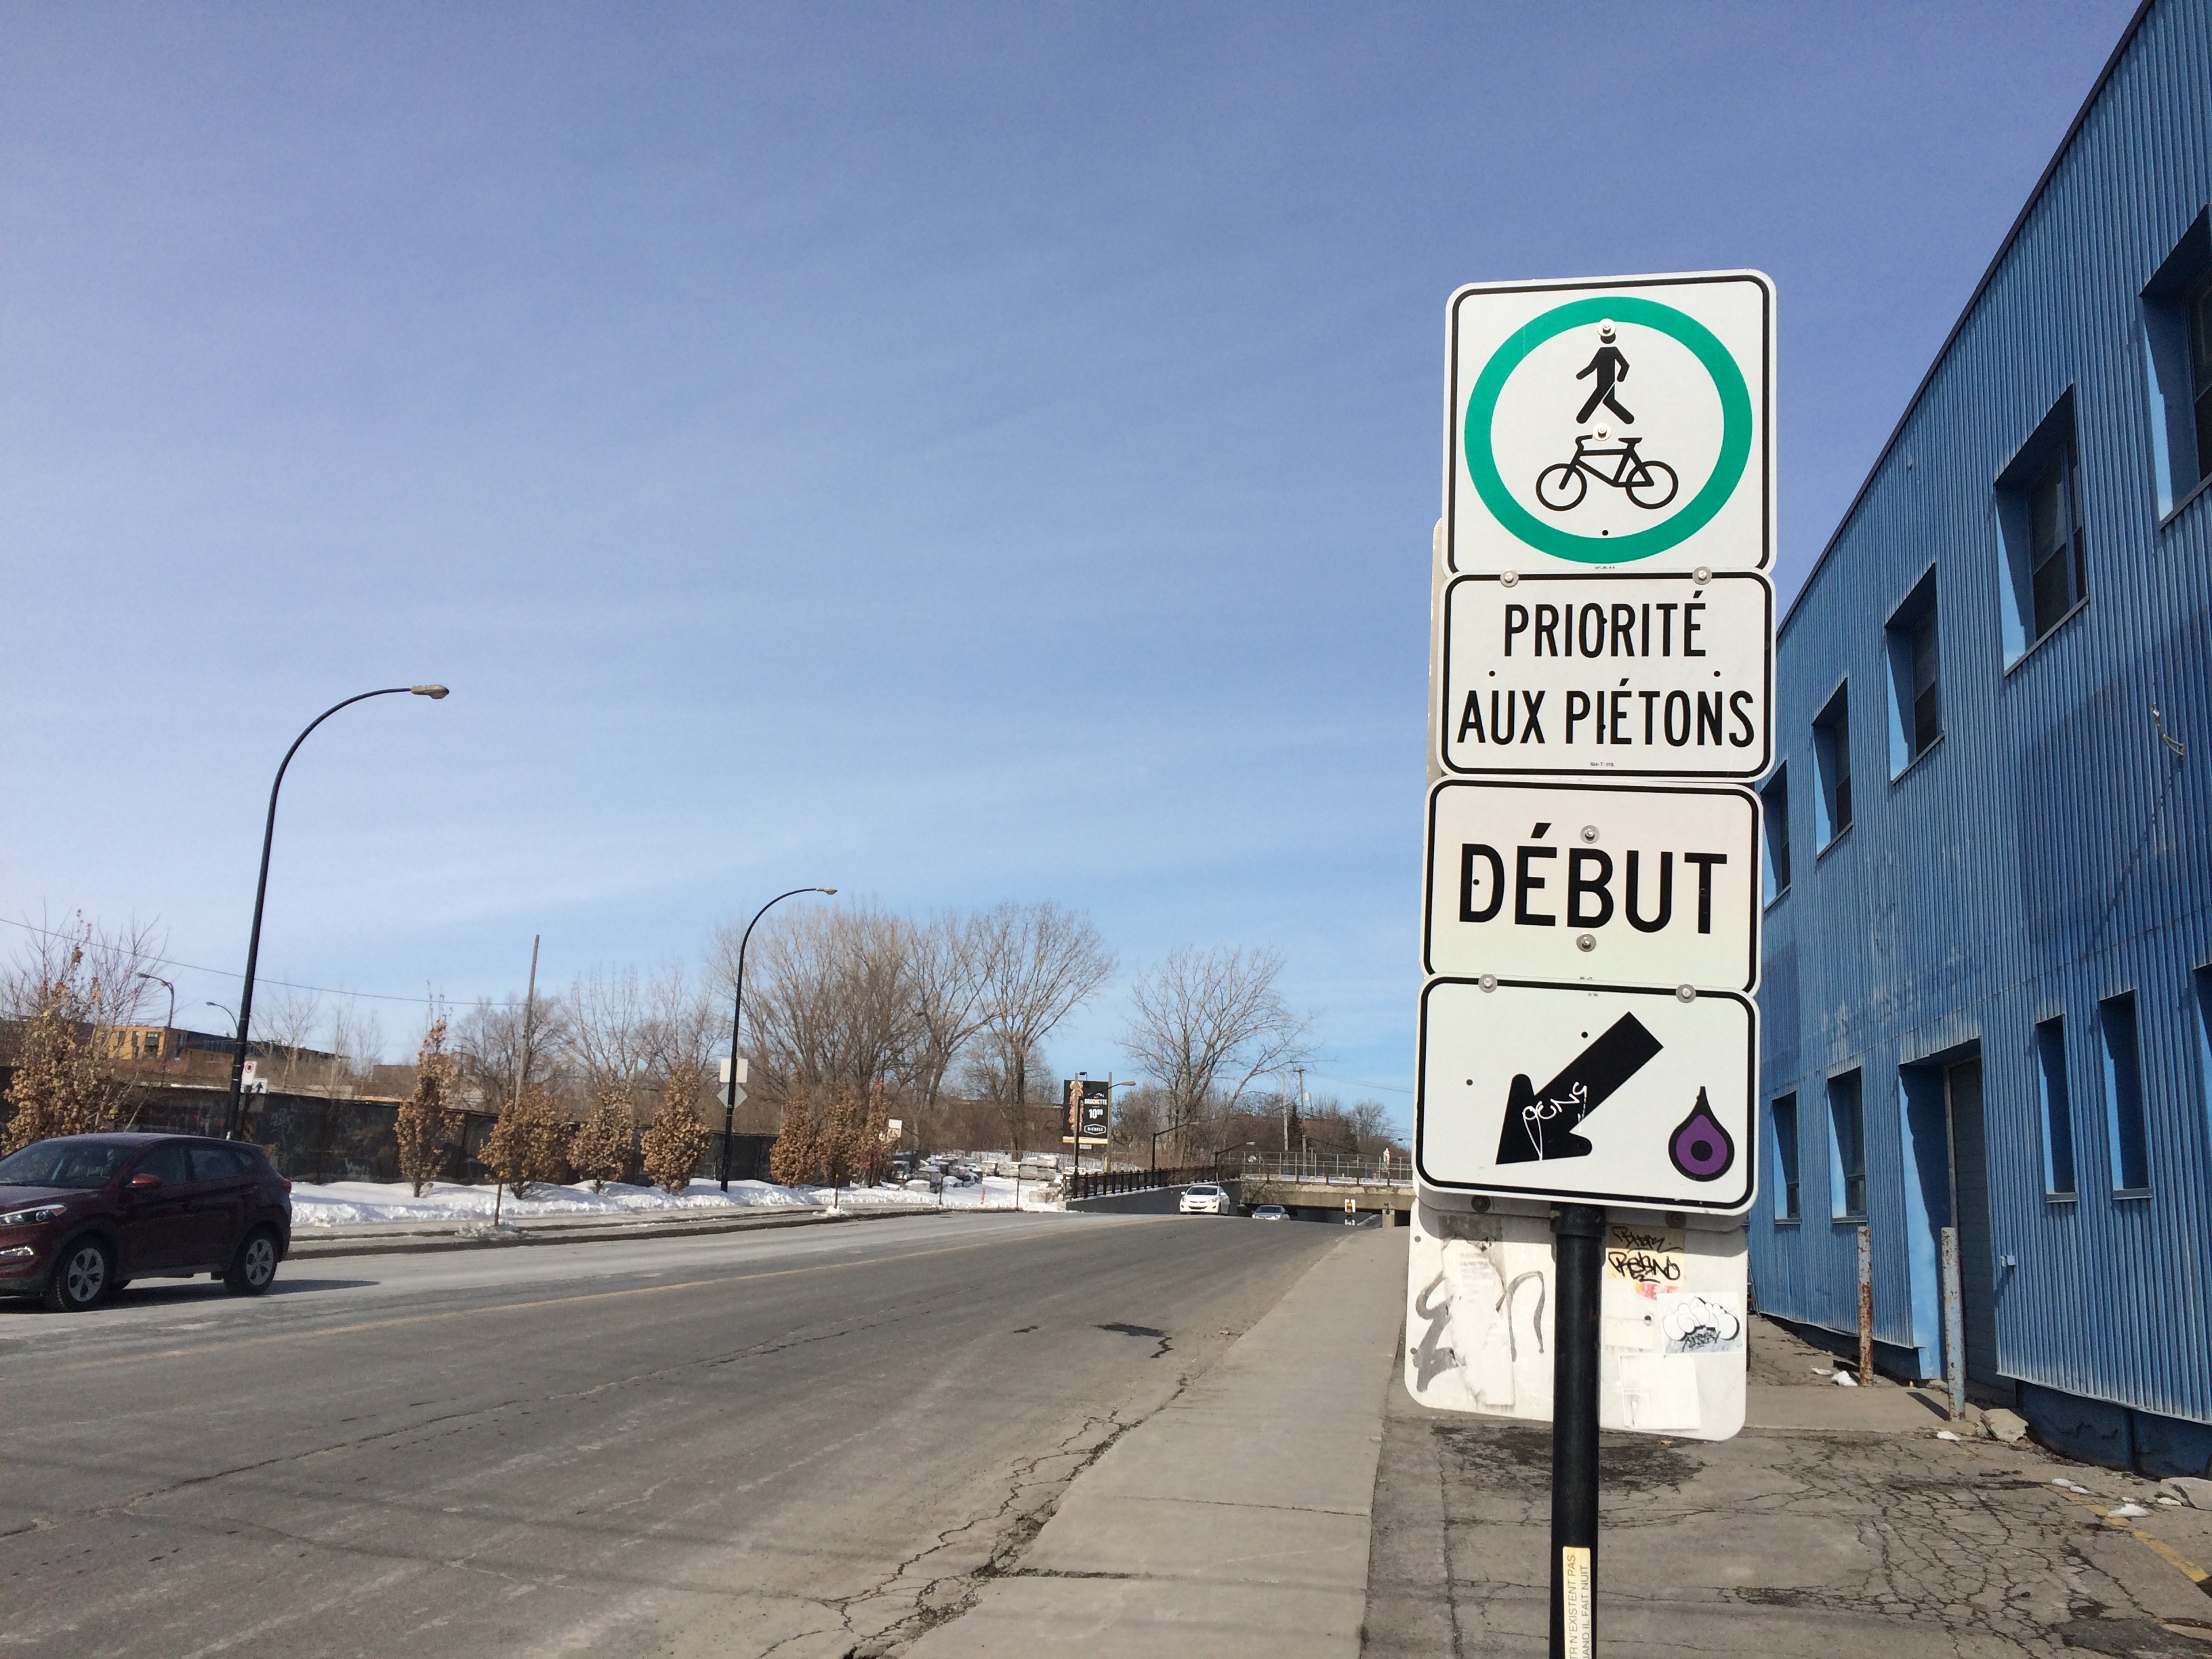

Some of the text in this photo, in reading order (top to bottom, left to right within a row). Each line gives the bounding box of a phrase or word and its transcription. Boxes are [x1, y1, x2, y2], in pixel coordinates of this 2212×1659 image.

[1504, 590, 1706, 659] PRIORITÉ
[1456, 678, 1755, 748] AUX PIÉTONS
[1459, 822, 1727, 935] DÉBUT
[1567, 1555, 1576, 1576] PAS
[1580, 1565, 1589, 1590] NUIT
[1580, 1594, 1590, 1617] FAIT
[1581, 1620, 1590, 1629] IL
